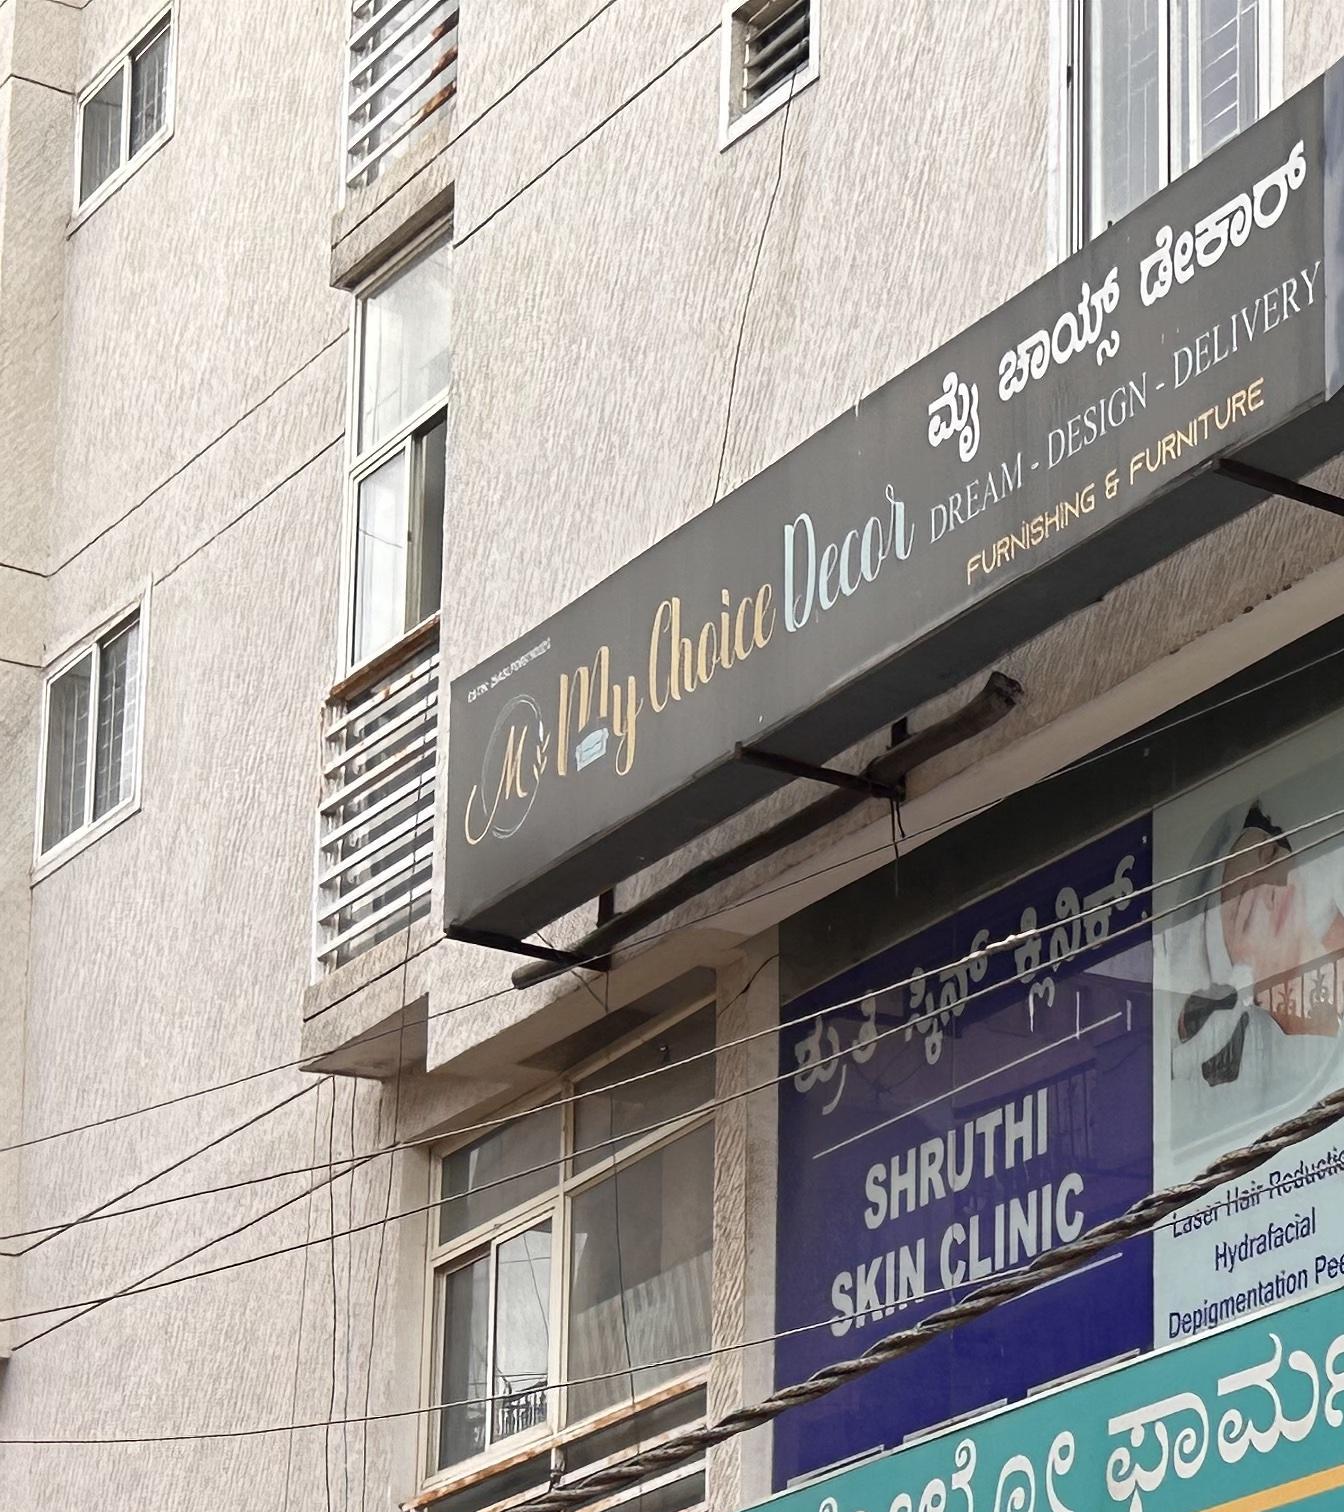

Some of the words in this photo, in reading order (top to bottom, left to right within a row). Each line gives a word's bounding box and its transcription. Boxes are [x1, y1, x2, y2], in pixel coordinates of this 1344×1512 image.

[930, 452, 1023, 545] DREAM
[1046, 382, 1148, 473] DESIGN
[1172, 261, 1324, 385] DELIVERY
[966, 485, 1095, 586] FURNISHING
[1105, 469, 1120, 500] &
[1128, 376, 1266, 484] FURNITURE
[558, 632, 645, 777] My
[649, 582, 777, 714] Choice
[782, 484, 916, 634] Decor
[864, 1088, 1049, 1231] SHRUTHI
[1172, 1207, 1220, 1239] Laser
[1226, 1178, 1262, 1214] Hair
[831, 1237, 926, 1337] SKIN
[939, 1173, 1085, 1290] CLINIC
[1168, 1269, 1308, 1340] Depigmentation
[1214, 1207, 1317, 1274] Hydrafacial
